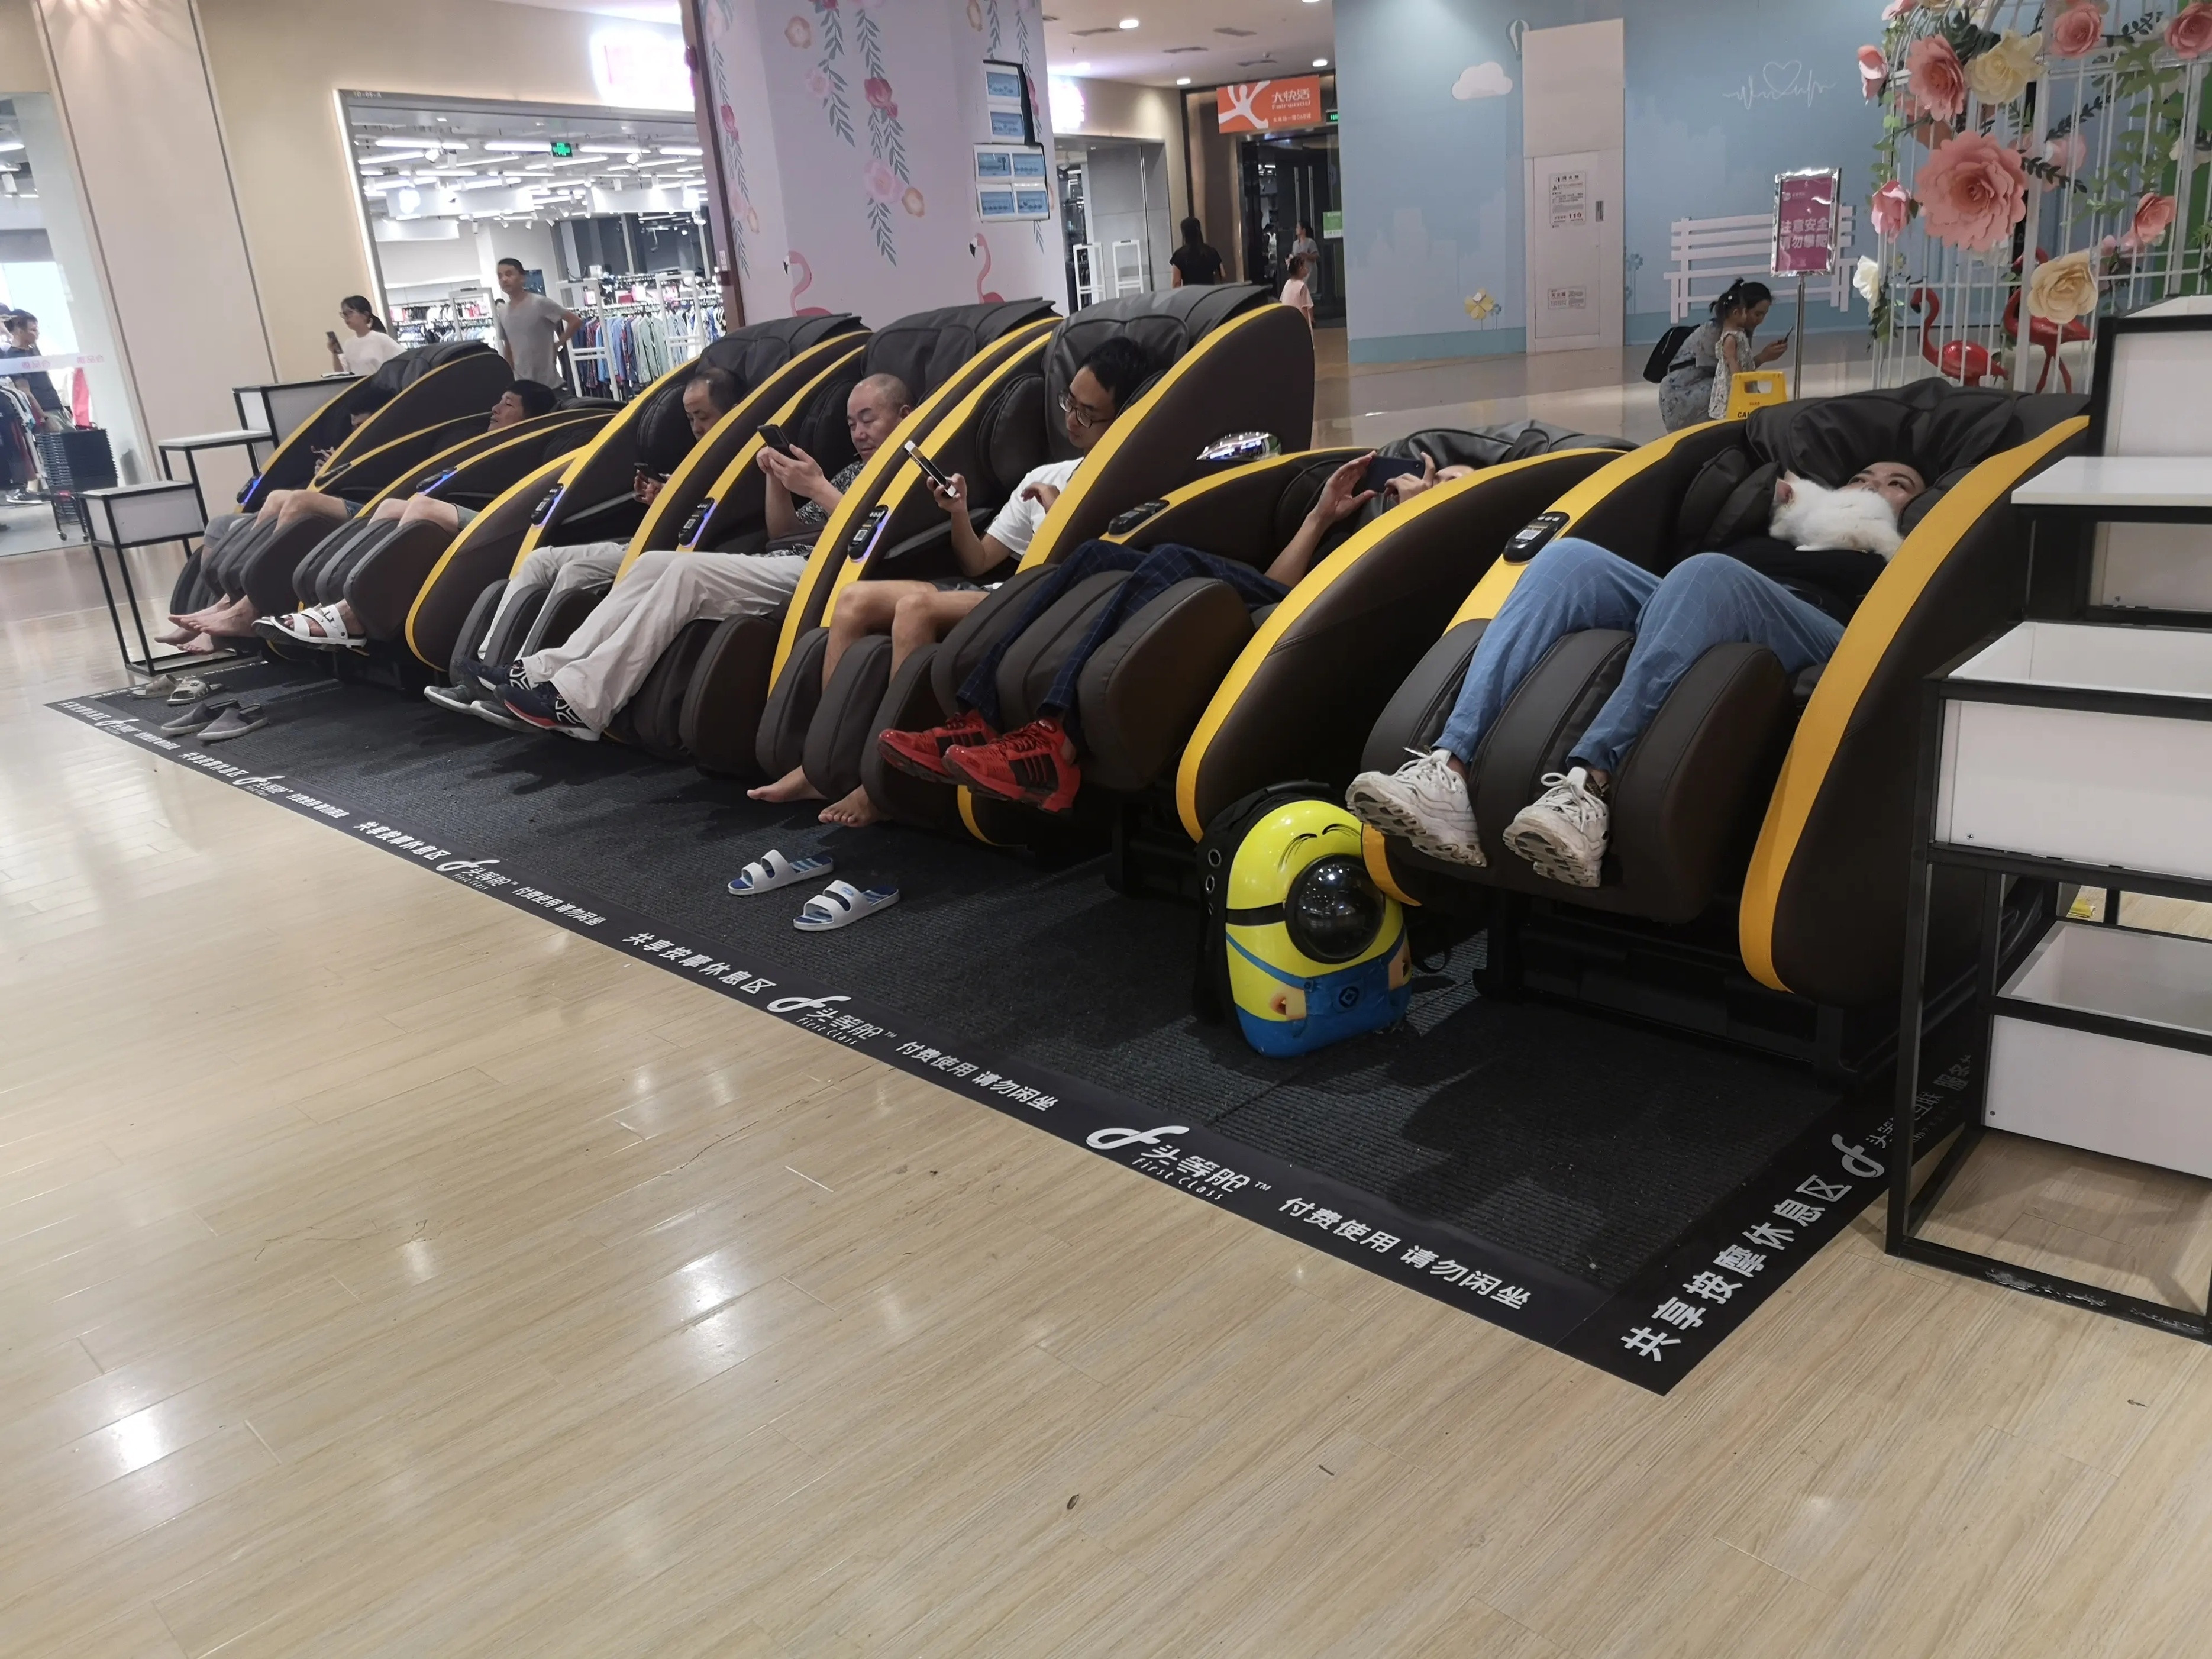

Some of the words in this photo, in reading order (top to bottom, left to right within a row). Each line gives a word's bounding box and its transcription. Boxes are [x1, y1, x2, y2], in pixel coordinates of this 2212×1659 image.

[1780, 217, 1829, 234] 注意安全
[353, 821, 451, 861] 共享按摩休息区
[512, 887, 564, 908] 付费使用
[554, 903, 606, 927] 请勿闲坐
[622, 932, 777, 995] 共享按摩休息区
[806, 1008, 884, 1040] 头等舱
[896, 1041, 980, 1078] 付费使用
[972, 1071, 1059, 1112] 请勿闲坐
[1141, 1144, 1250, 1192] 头等舱
[1178, 1177, 1223, 1200] Class
[1278, 1198, 1401, 1254] 付费使用
[1400, 1245, 1532, 1310] 请勿闲坐
[1620, 1174, 1852, 1362] 共享按摩休息区
